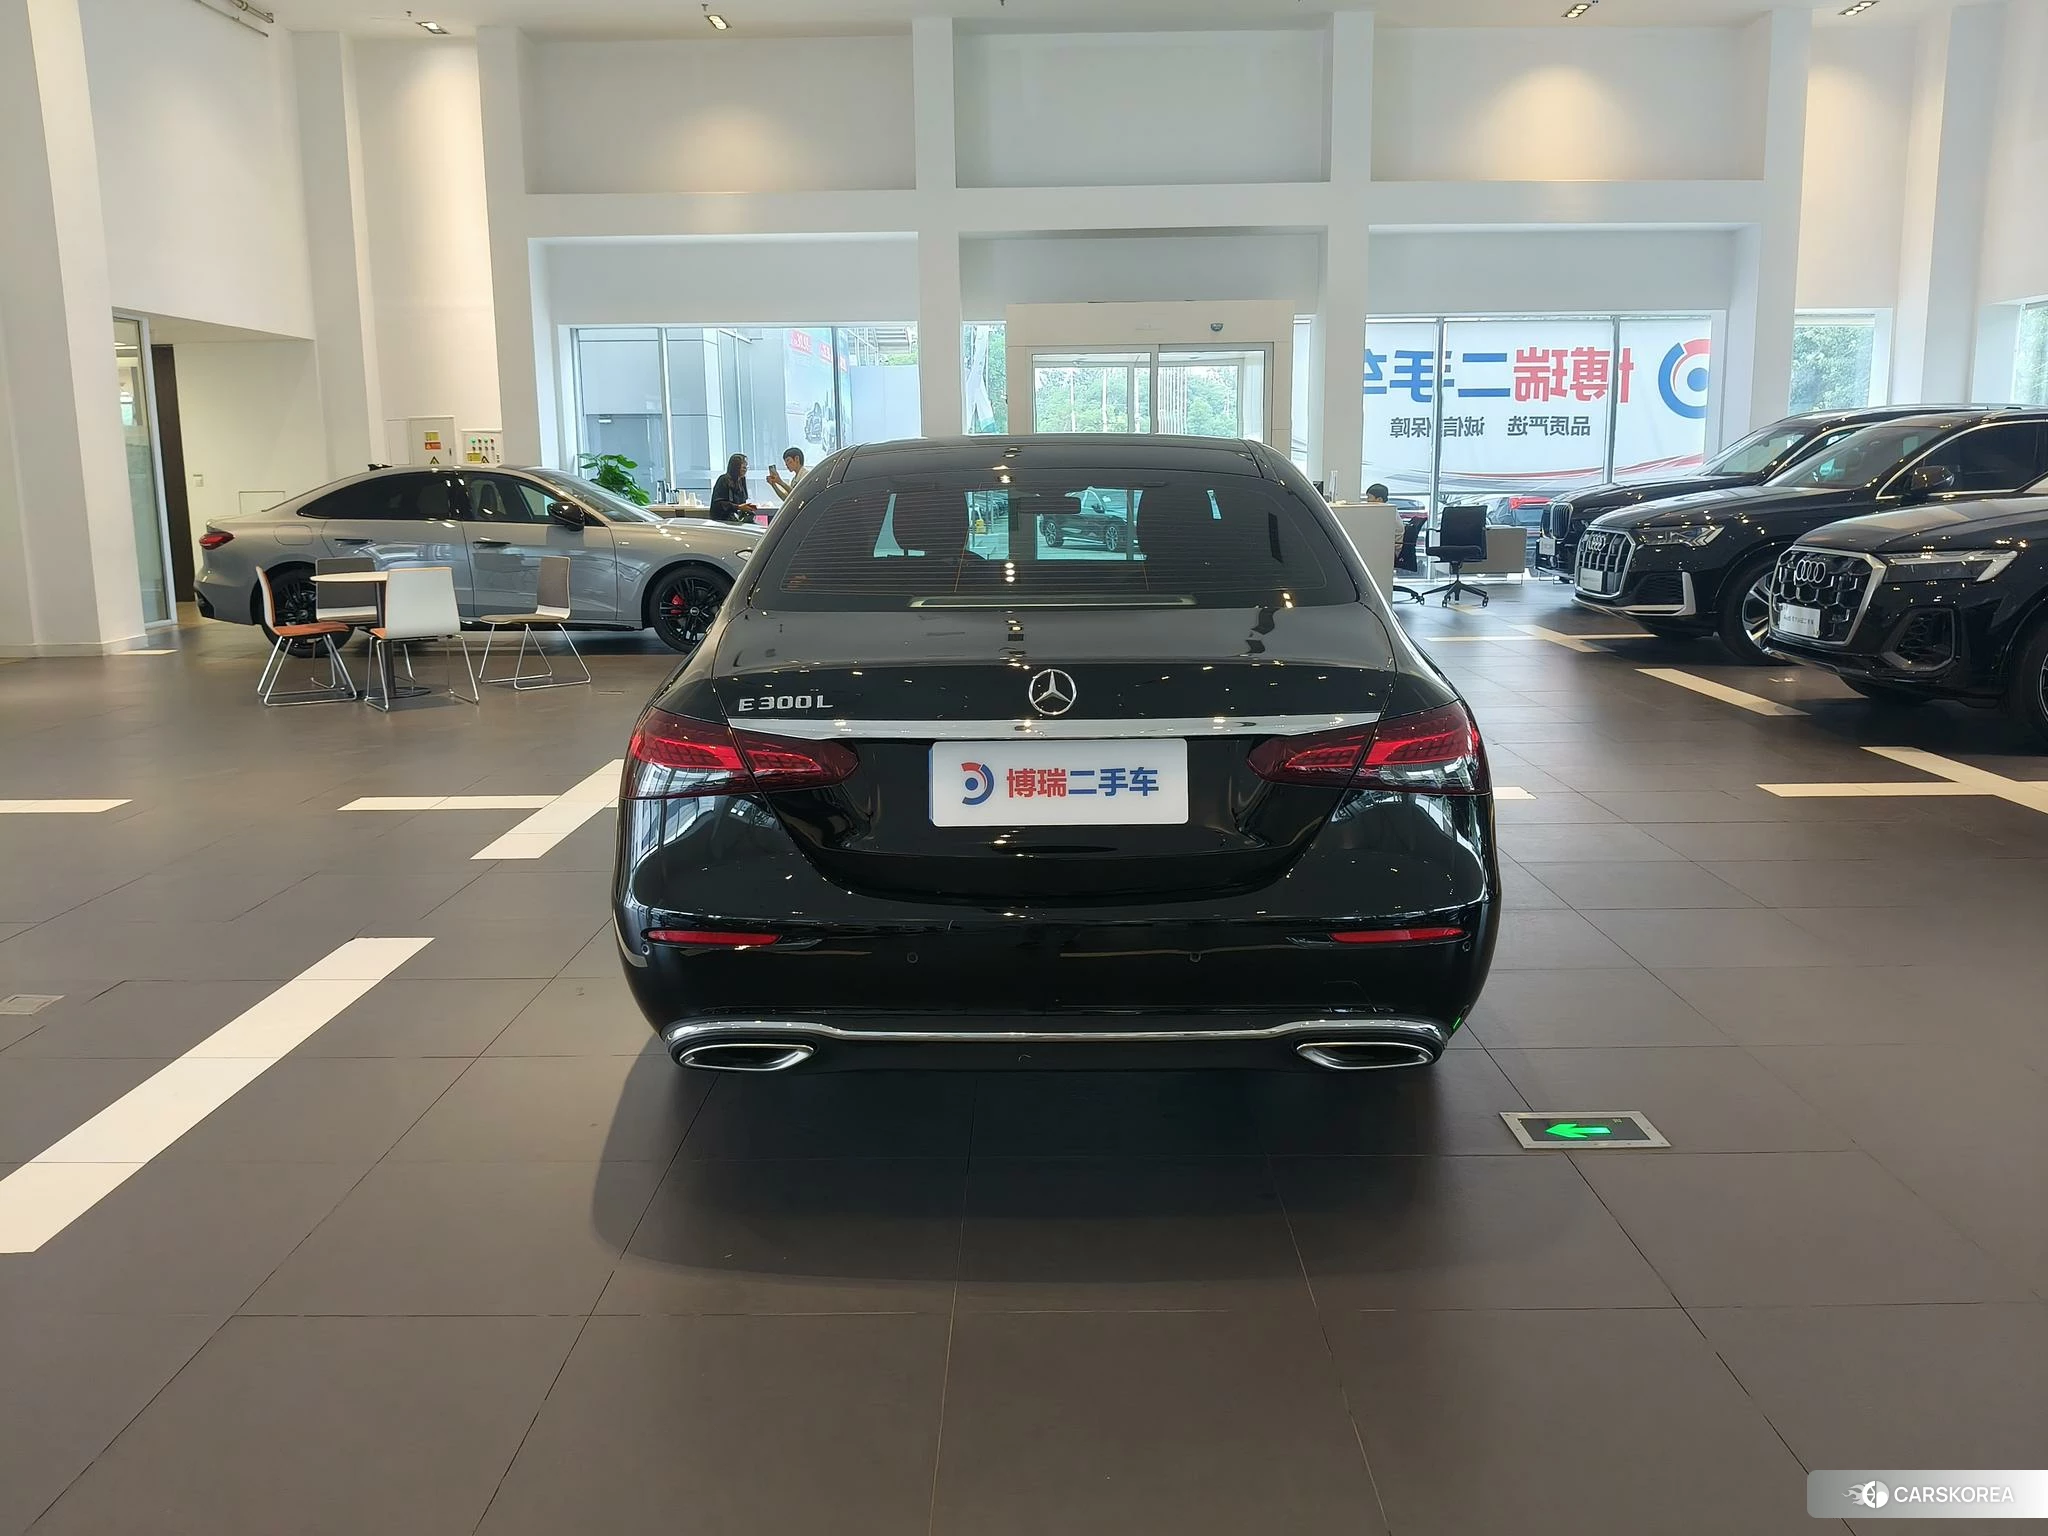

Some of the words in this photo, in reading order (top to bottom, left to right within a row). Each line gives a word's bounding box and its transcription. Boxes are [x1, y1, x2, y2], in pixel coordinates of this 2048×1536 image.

[1006, 766, 1160, 799] 博瑞二手车
